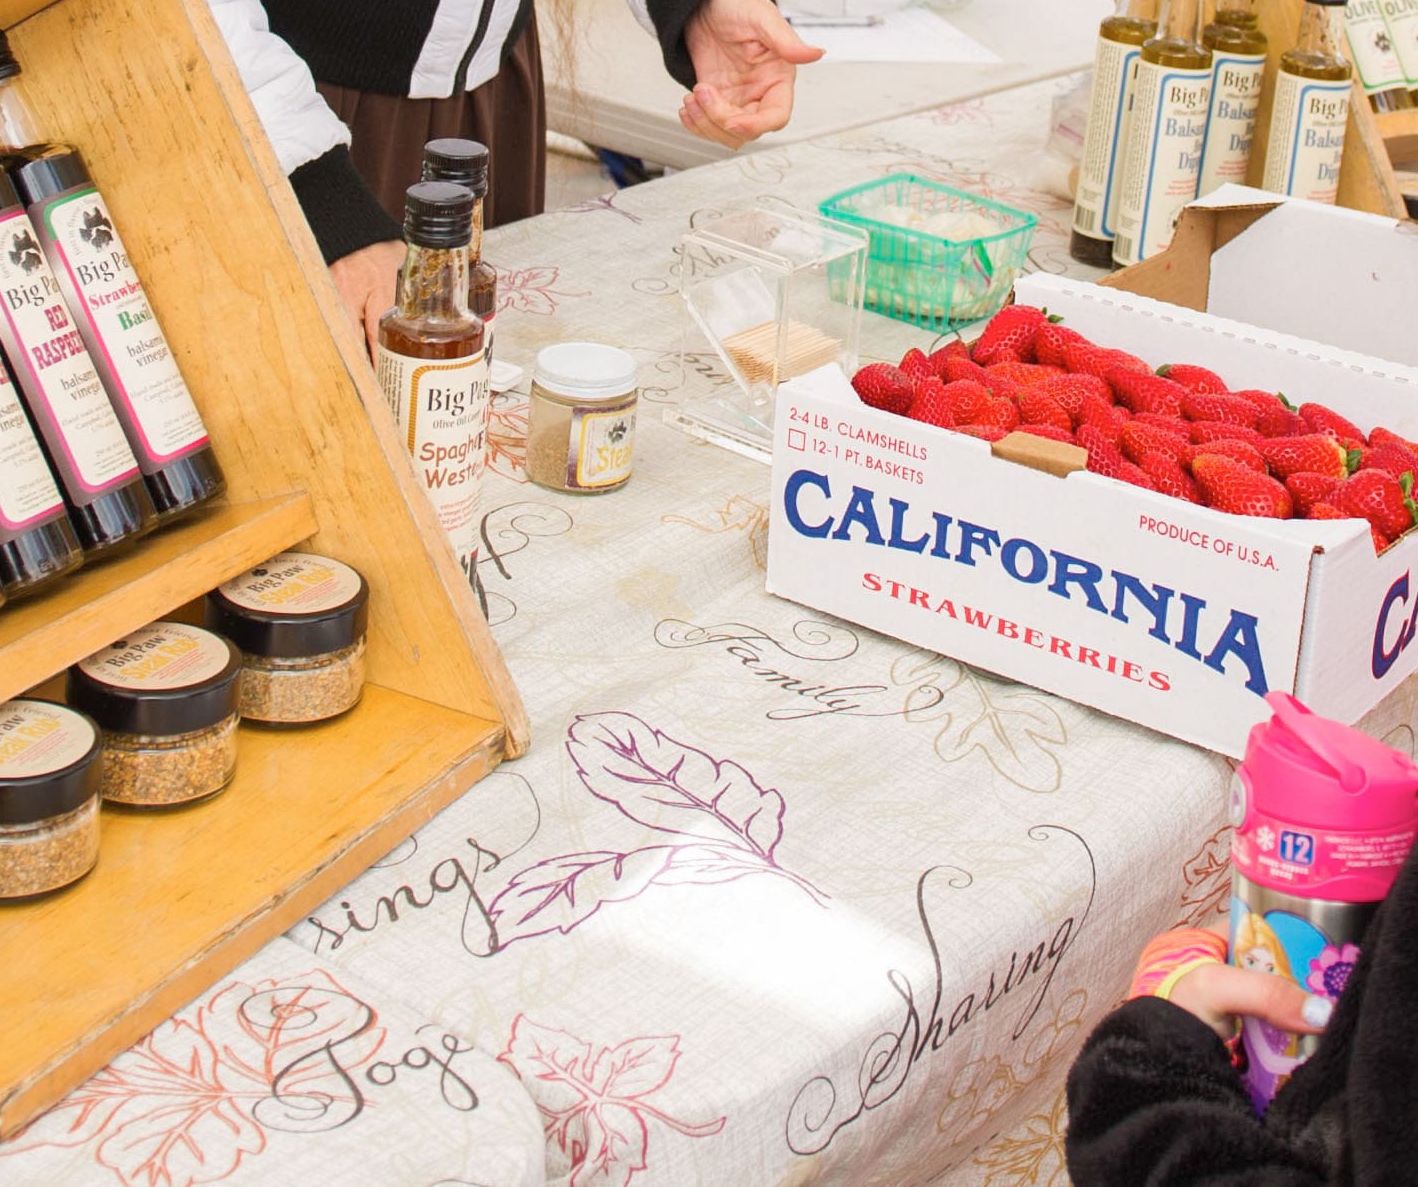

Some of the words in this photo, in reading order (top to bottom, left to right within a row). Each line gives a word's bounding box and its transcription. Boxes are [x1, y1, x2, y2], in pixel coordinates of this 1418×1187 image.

[1223, 70, 1250, 92] Big
[1170, 86, 1196, 108] Big
[1310, 98, 1336, 119] Big
[76, 260, 116, 287] Big
[6, 284, 46, 310] Big
[44, 304, 69, 332] RED
[427, 387, 466, 417] Big
[432, 418, 456, 431] Olive
[788, 406, 812, 424] 2-4
[813, 412, 834, 433] LB.
[836, 420, 929, 463] CLAMSHELLS
[811, 438, 842, 459] 12-1
[843, 446, 865, 468] PT.
[864, 453, 926, 486] BASKETS
[1138, 514, 1211, 551] PRODUCE
[1212, 536, 1236, 556] OF
[1237, 542, 1280, 573] U.S.A.
[247, 578, 282, 595] Big
[275, 564, 304, 582] Paw
[783, 467, 1270, 698] CALIFORNIA
[861, 570, 1173, 693] STRAWBERRIES
[105, 650, 143, 669] Big
[134, 634, 168, 654] Paw
[119, 652, 172, 680] Steak
[158, 638, 200, 656] Rub
[654, 618, 945, 720] Family
[16, 716, 63, 738] Rub
[1282, 834, 1312, 864] 12
[786, 823, 1097, 1156] Sharing
